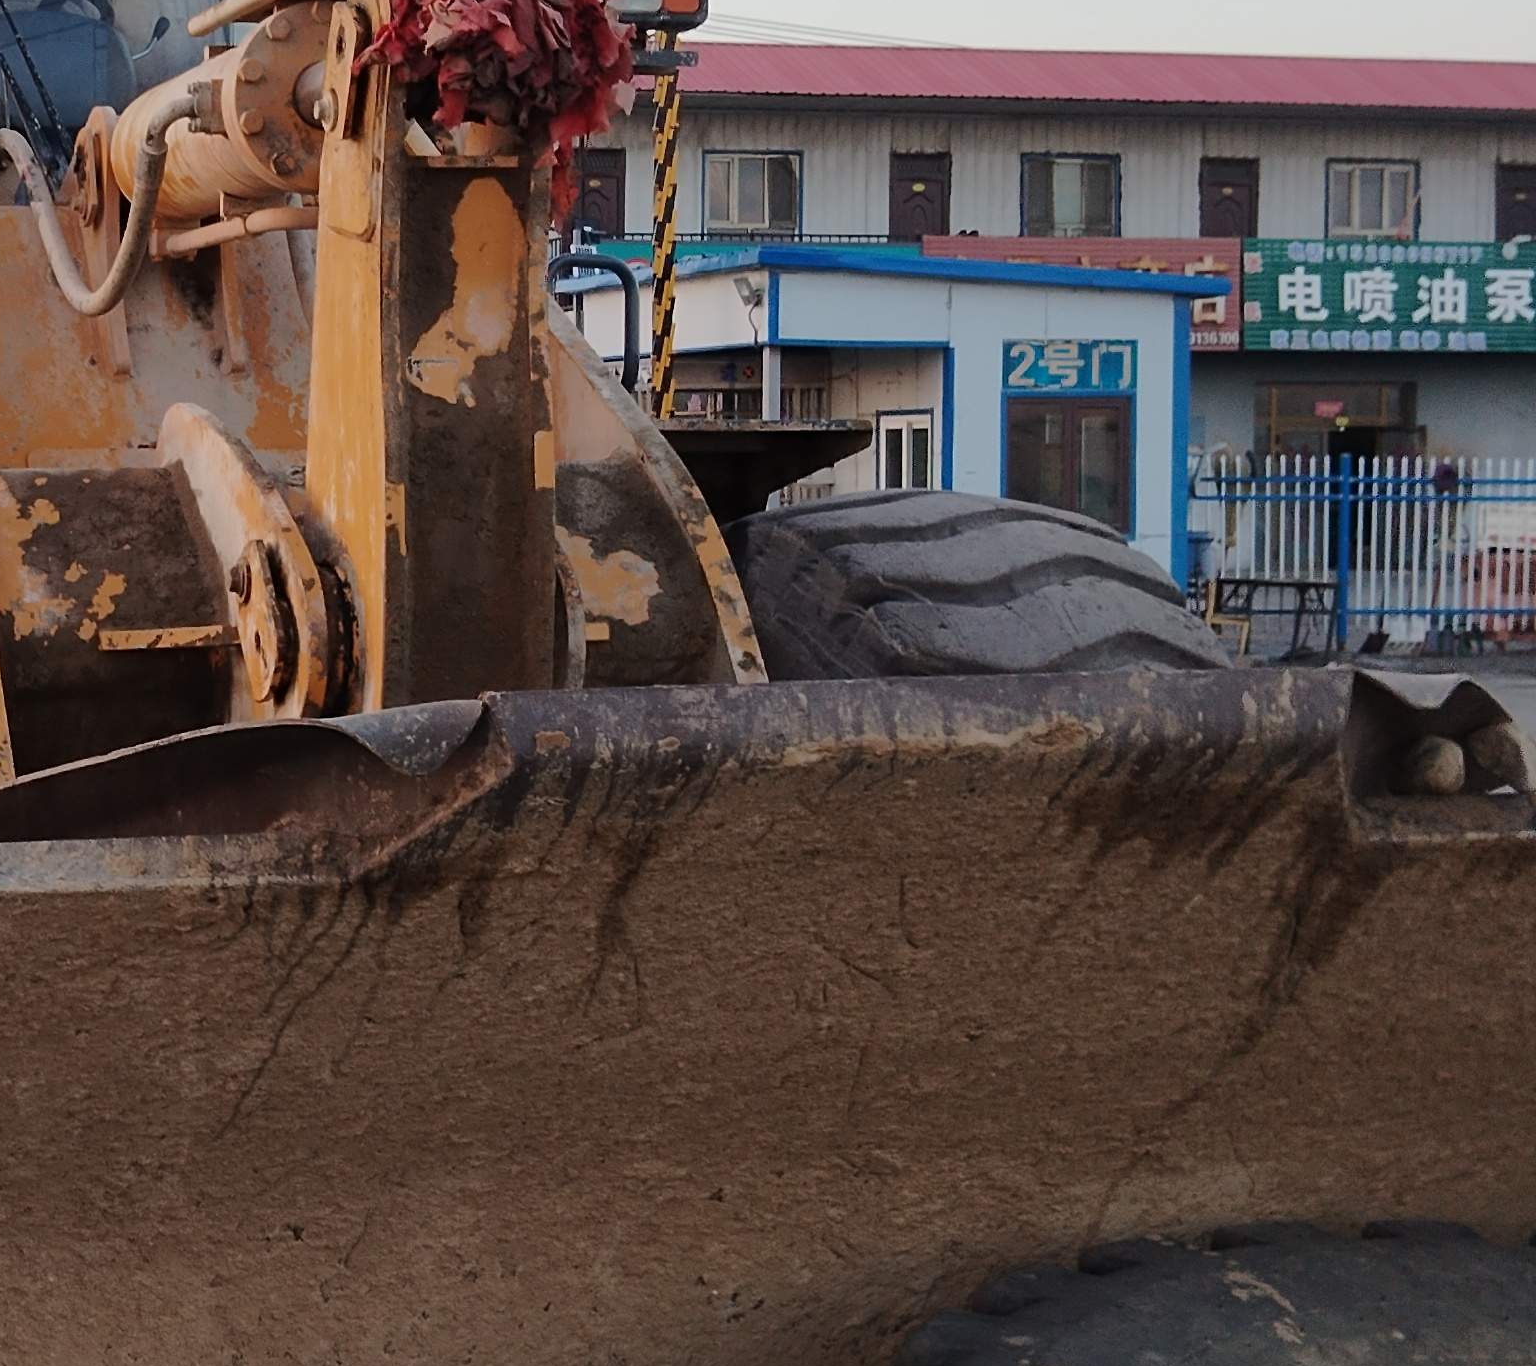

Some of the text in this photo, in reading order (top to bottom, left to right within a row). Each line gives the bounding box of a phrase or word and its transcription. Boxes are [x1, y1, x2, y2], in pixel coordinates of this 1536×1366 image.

[1277, 265, 1536, 325] 电喷油泵
[1007, 342, 1133, 389] 2号门
